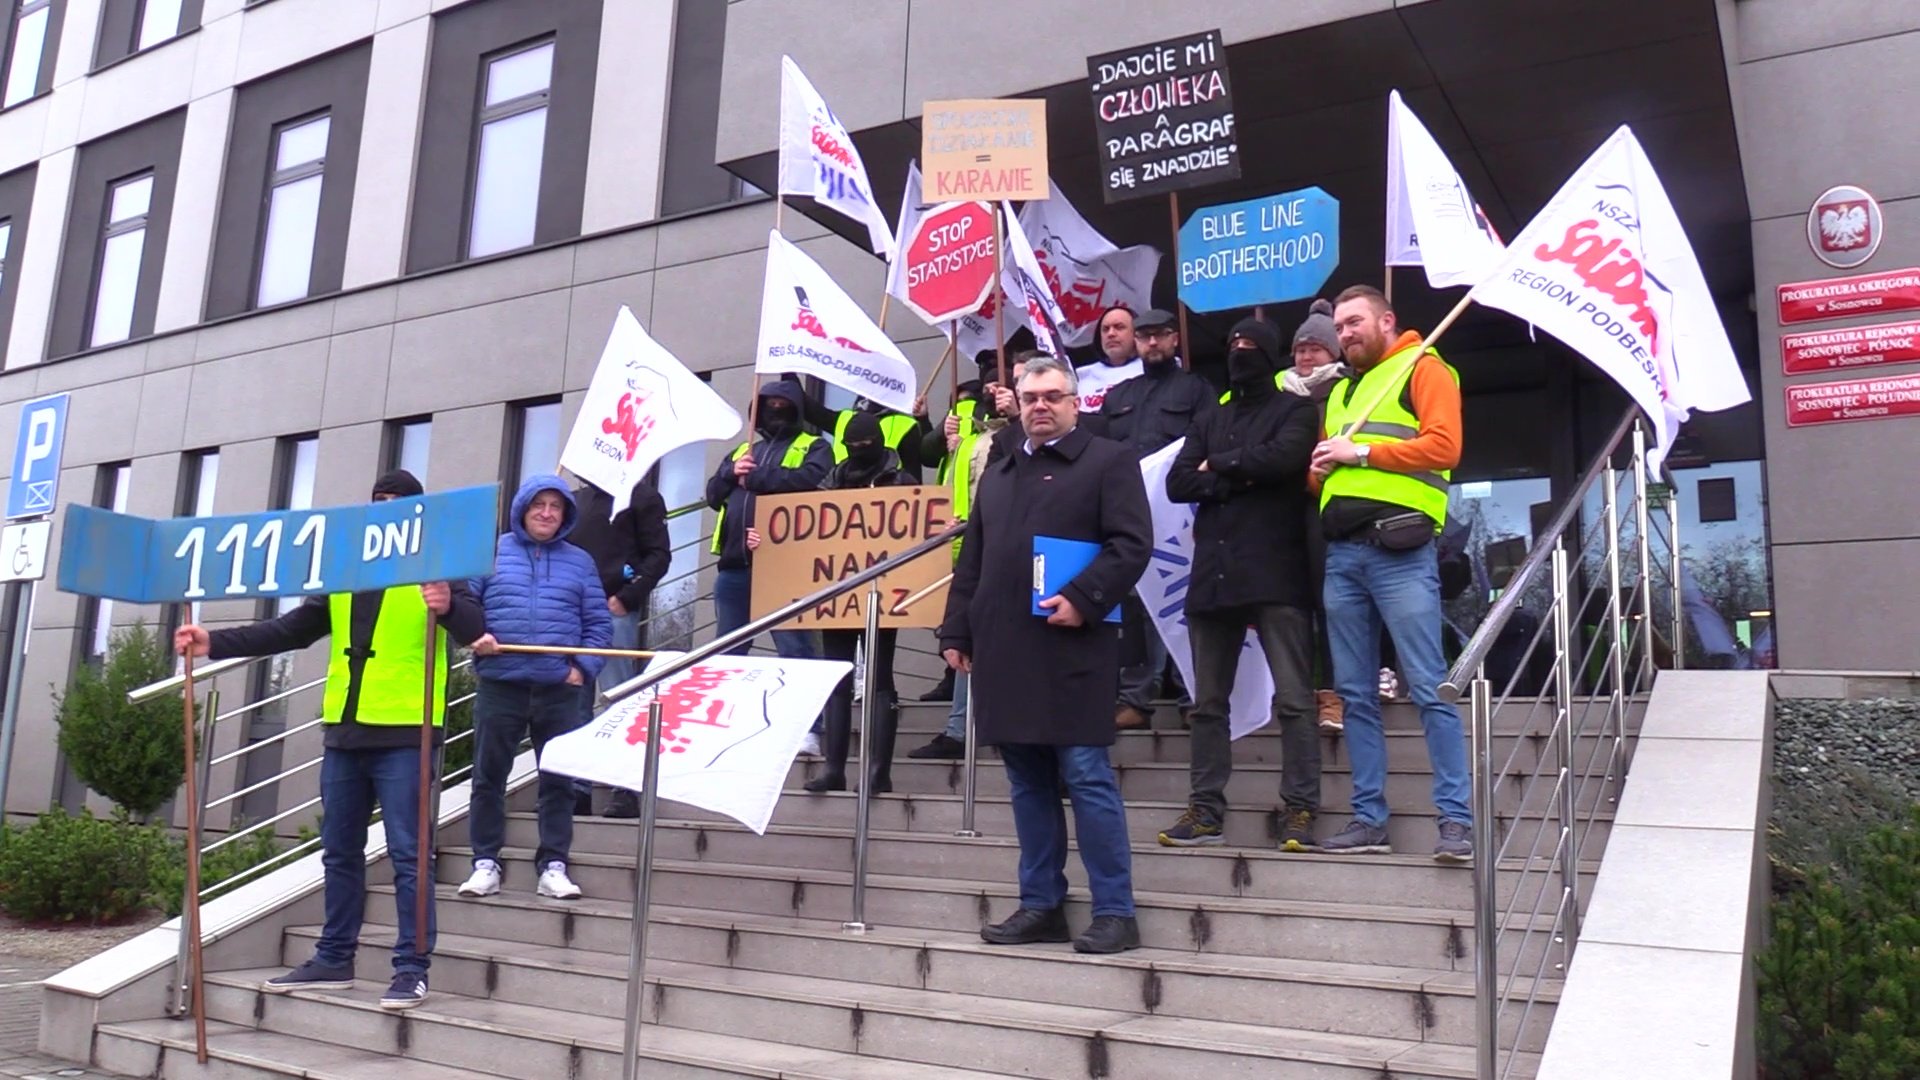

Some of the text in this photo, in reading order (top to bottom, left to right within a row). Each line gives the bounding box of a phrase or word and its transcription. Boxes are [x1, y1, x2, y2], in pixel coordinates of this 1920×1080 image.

[1186, 34, 1215, 66] MI
[1099, 70, 1226, 122] CZŁOWIEKA
[1106, 114, 1234, 159] PARAGRAF
[1155, 114, 1170, 129] A
[937, 168, 1033, 196] KARANIE
[1110, 167, 1136, 189] SIĘ
[1202, 199, 1306, 241] BLUE LINE
[1591, 200, 1640, 233] NSZZ
[928, 216, 973, 252] STOP
[908, 235, 994, 288] STATYSTYCE
[1182, 232, 1324, 286] BROTHERHOOD
[1508, 268, 1580, 307] REGION
[1781, 276, 1920, 302] PROKURATURA OKRĘGOWA
[1816, 297, 1883, 312] w Sosnowcu
[1786, 325, 1920, 349] PROKURATURA REJONOW
[1798, 343, 1860, 359] SOSNOWIEC
[1790, 384, 1868, 400] PROKURATURA
[1797, 395, 1860, 412] SOSNOWIEC
[20, 407, 57, 482] P
[768, 488, 950, 545] ODDAJCIE
[174, 503, 425, 598] 1111 DNI
